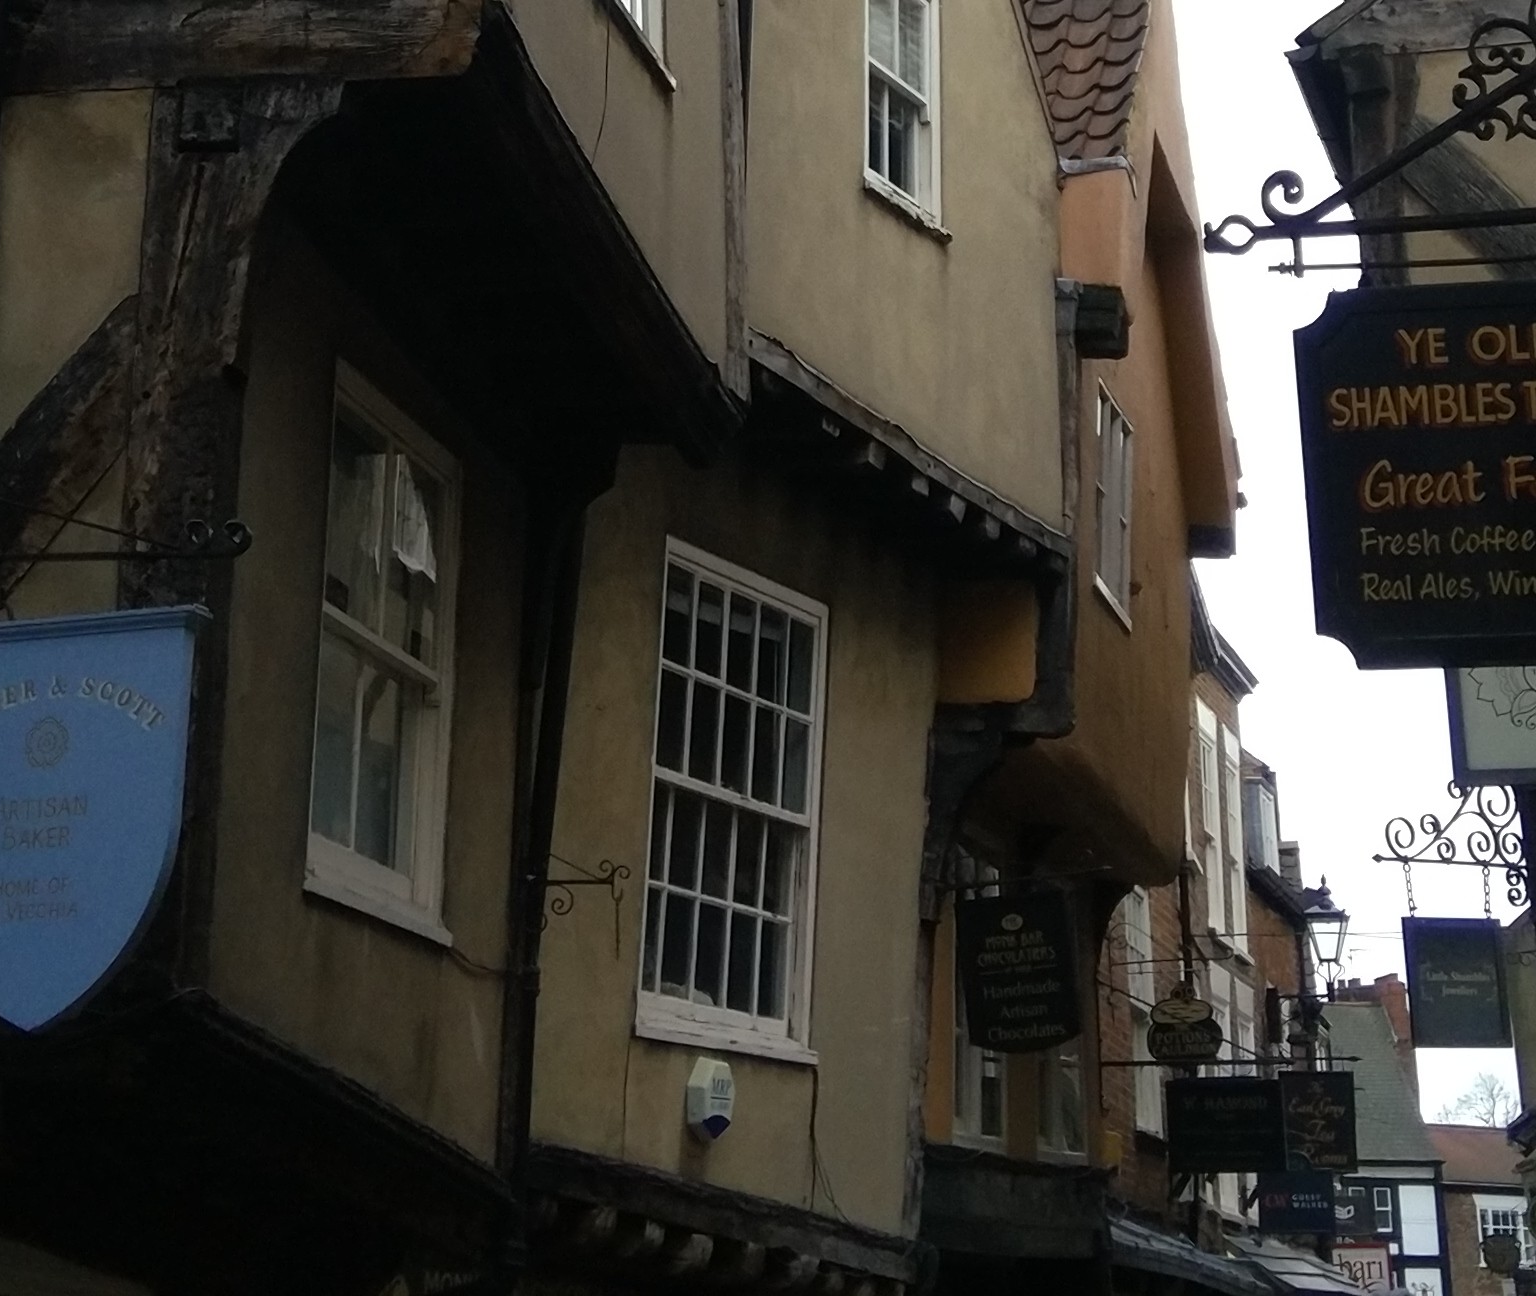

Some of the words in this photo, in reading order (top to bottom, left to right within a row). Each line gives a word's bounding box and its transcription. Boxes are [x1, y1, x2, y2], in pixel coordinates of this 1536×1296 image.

[1395, 327, 1449, 366] YE
[1329, 383, 1517, 430] SHAMBLES
[1362, 457, 1486, 511] Great
[1360, 523, 1440, 558] Fresh
[1450, 524, 1536, 556] Coffee
[1360, 571, 1413, 602] Real
[1419, 570, 1480, 601] Ales,
[81, 676, 167, 733] SCOTT
[983, 978, 1062, 1001] Handmade
[1000, 1004, 1049, 1019] Artisan
[988, 1023, 1067, 1042] Chocolates
